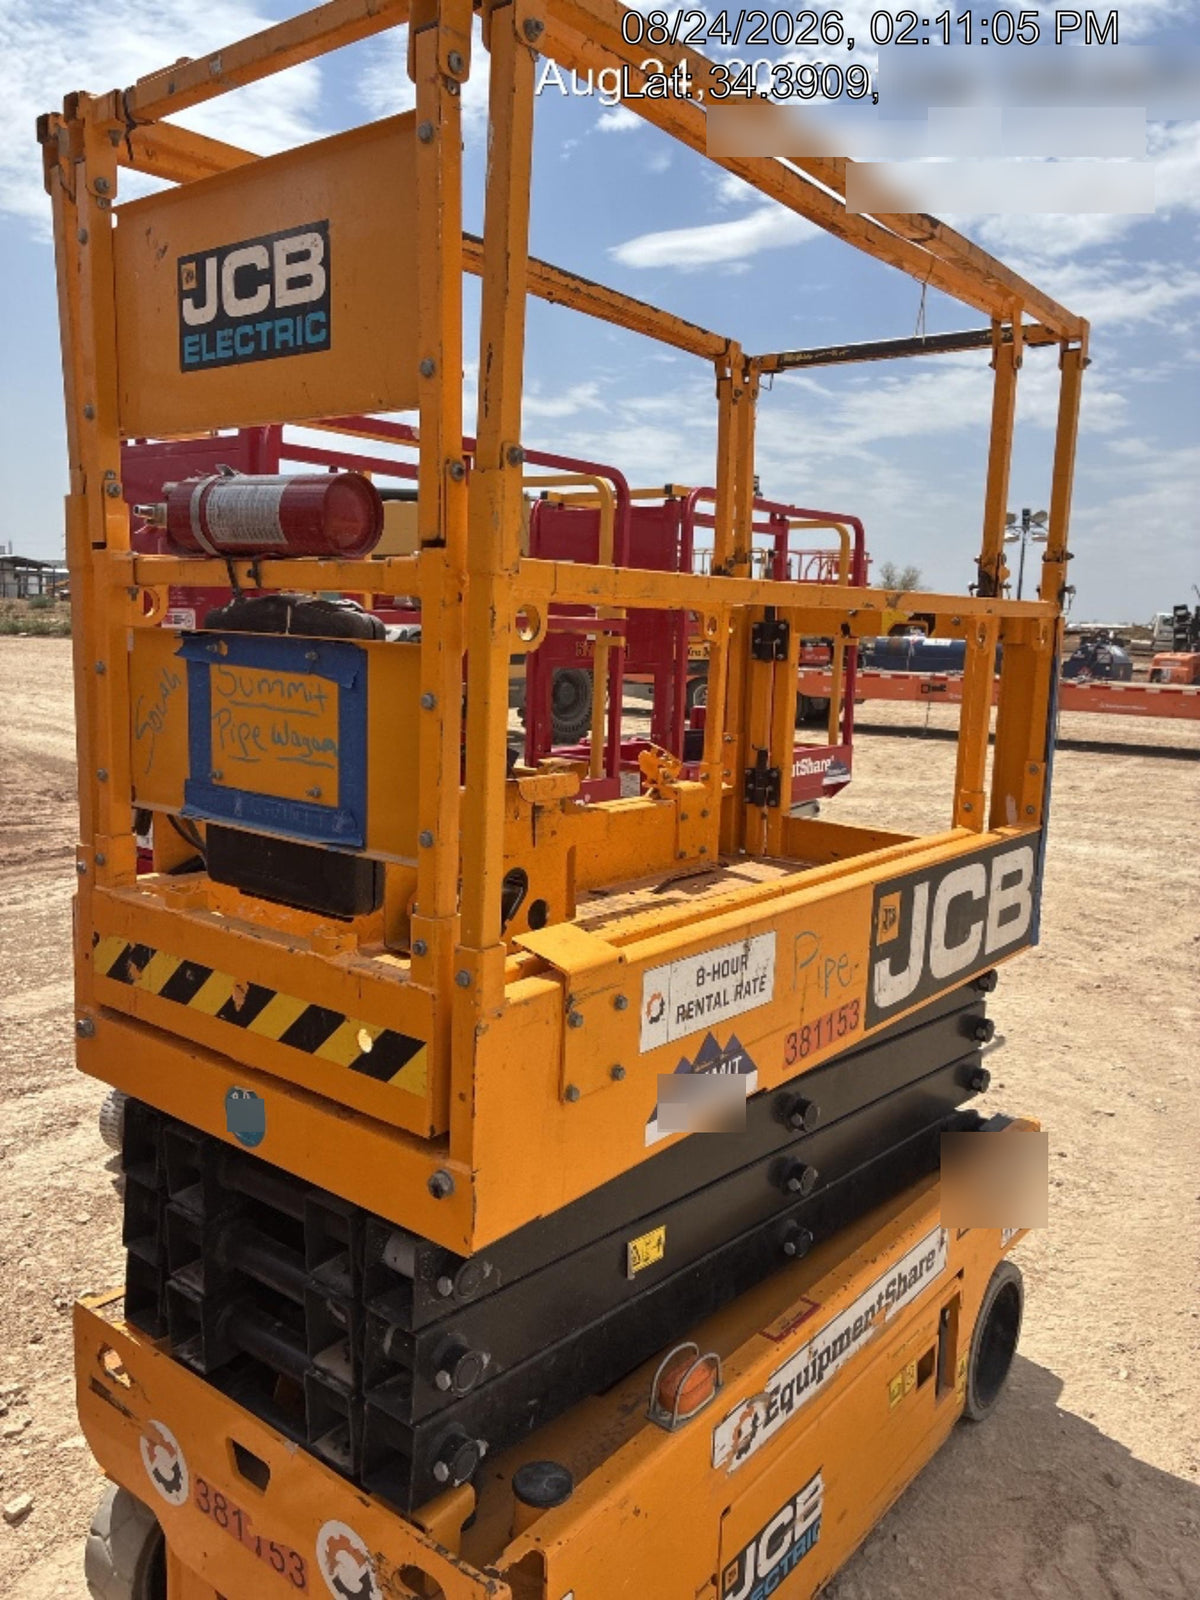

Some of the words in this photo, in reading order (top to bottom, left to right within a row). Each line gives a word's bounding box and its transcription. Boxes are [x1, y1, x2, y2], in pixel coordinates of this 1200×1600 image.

[182, 232, 327, 326] JCB
[183, 311, 327, 364] ELECTRIC
[212, 708, 266, 757] Pipe
[874, 845, 1034, 1009] JCB
[675, 991, 730, 1026] RENTAL
[734, 973, 767, 1009] RATE
[696, 954, 749, 988] 8-HOUR
[785, 1000, 861, 1066] 381153
[762, 1249, 936, 1429] EquipmentShare
